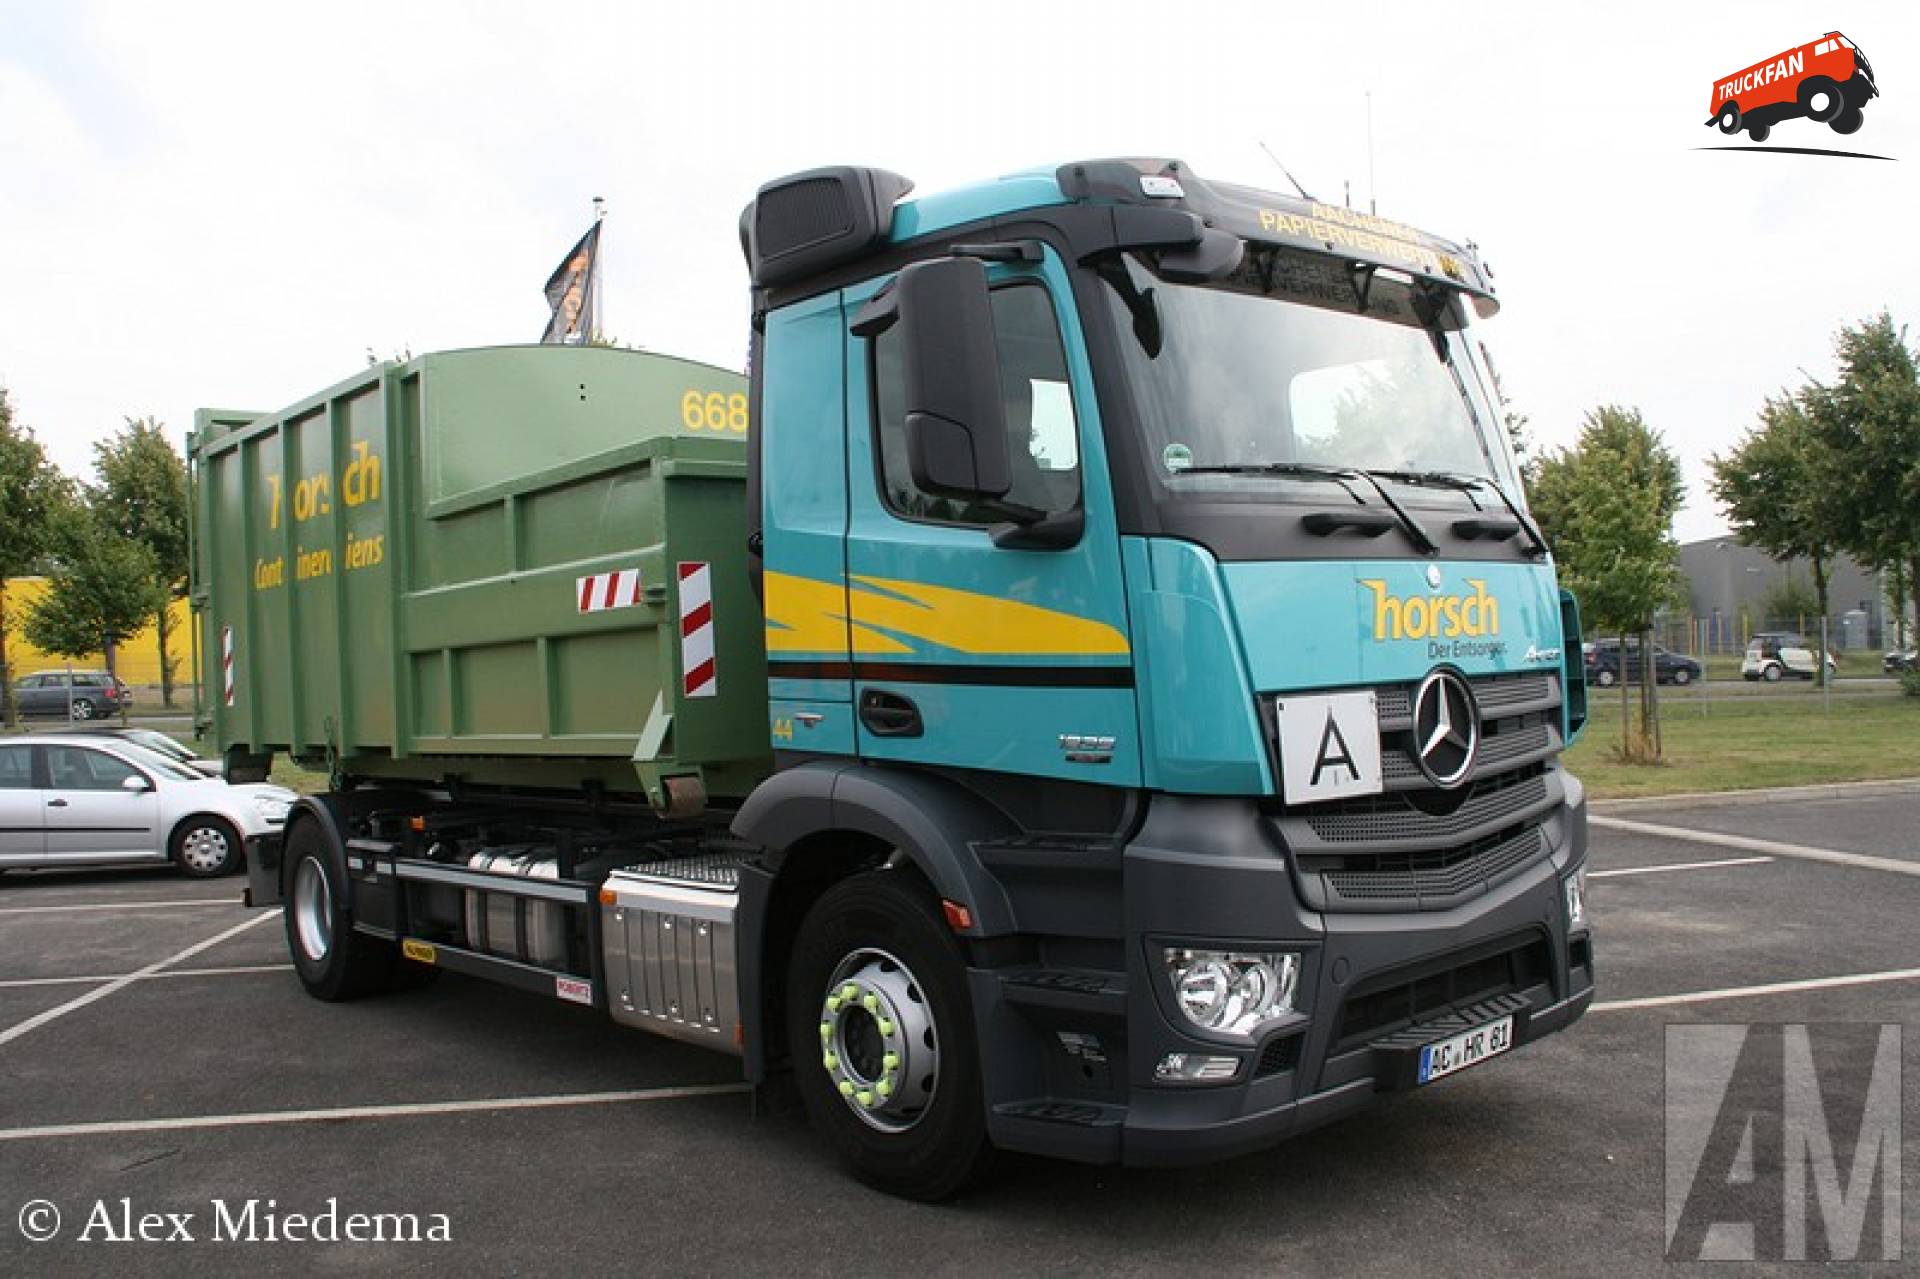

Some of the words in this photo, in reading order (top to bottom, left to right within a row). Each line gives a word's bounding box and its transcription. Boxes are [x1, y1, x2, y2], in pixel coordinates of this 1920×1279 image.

[682, 389, 750, 433] 668
[1357, 578, 1499, 640] horsch
[1427, 641, 1450, 659] Der
[1310, 704, 1361, 785] A
